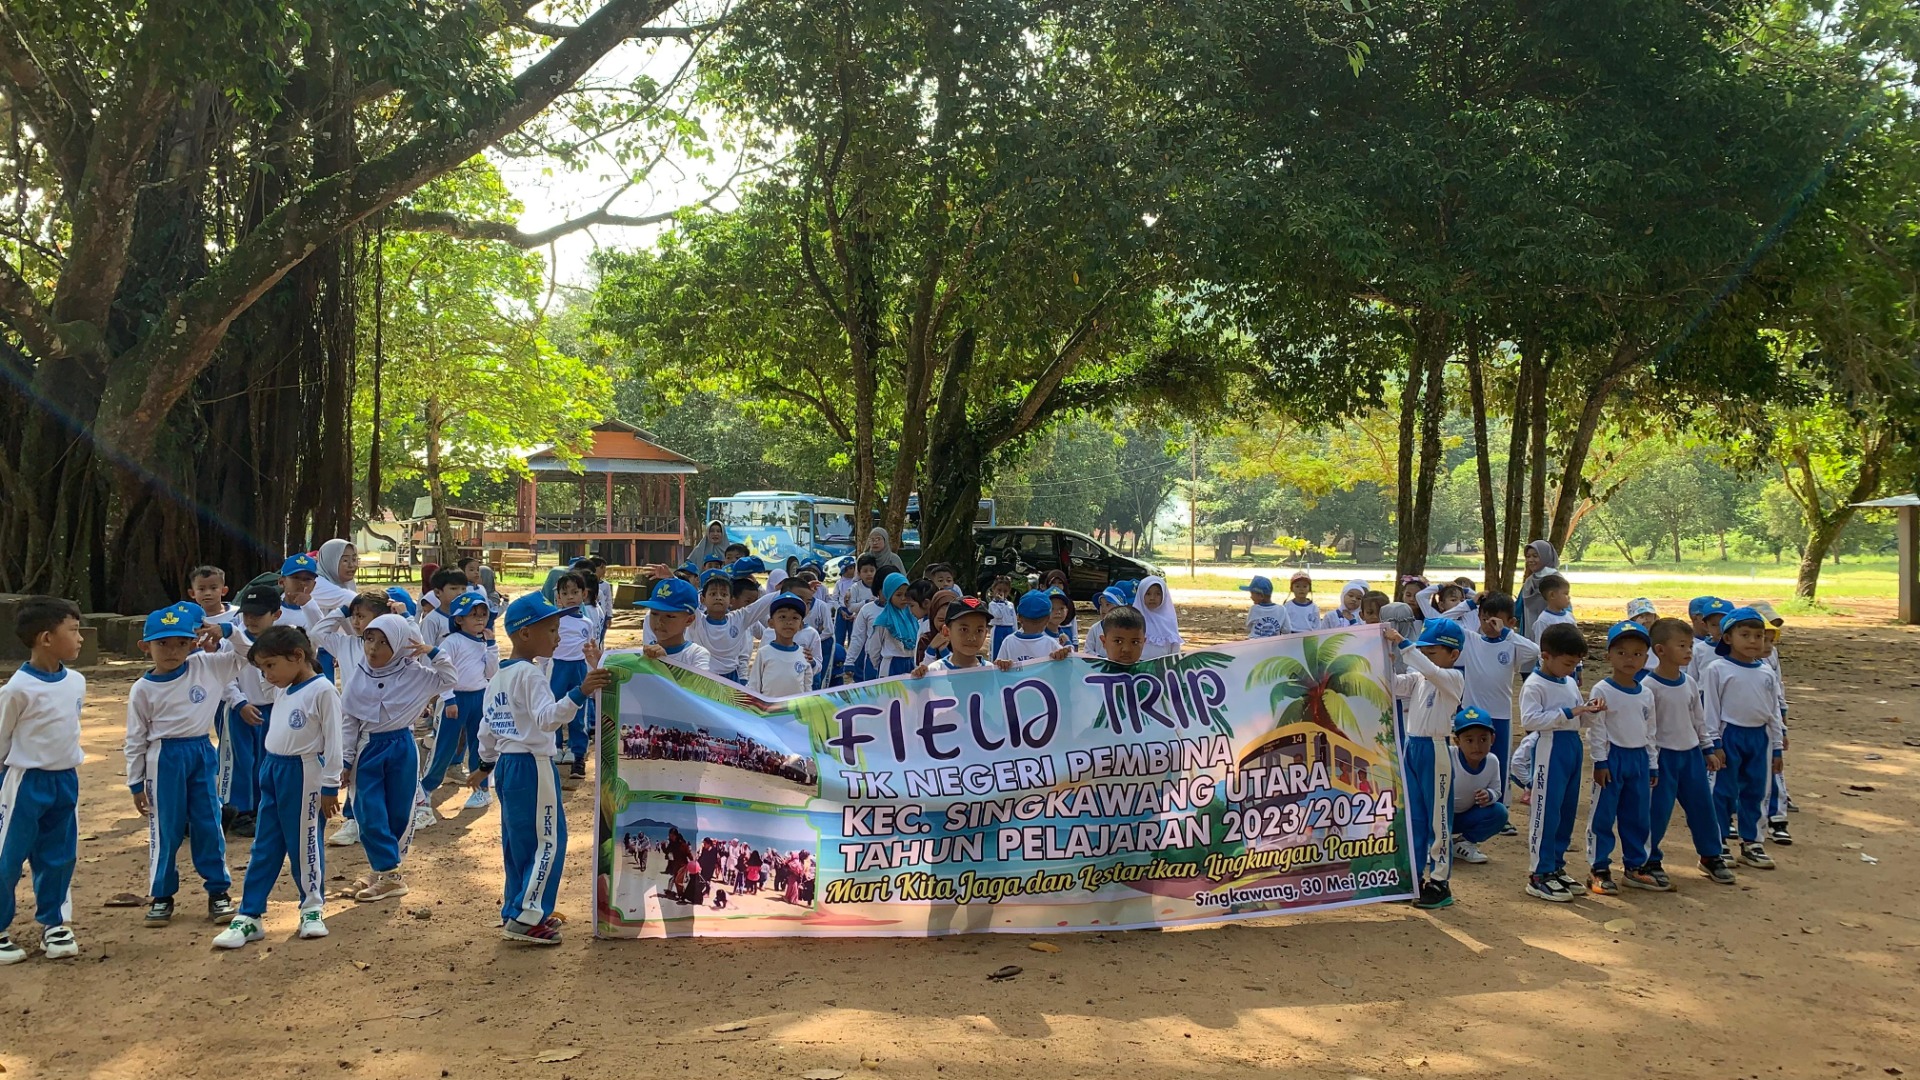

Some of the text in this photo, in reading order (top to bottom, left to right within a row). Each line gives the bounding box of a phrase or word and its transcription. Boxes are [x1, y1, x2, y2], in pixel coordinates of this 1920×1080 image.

[828, 670, 1226, 765] FIELD TRIP
[1291, 734, 1303, 744] 14
[840, 734, 1233, 799] TK NEGERI PEMBINA
[842, 761, 1332, 838] KEC. SINGKAWANG UTARA
[307, 791, 318, 892] TKN PEMBINA
[839, 789, 1396, 873] TAHUN PELAJARAN 2023/2024
[1438, 805, 1448, 864] PEMBINA
[1531, 765, 1545, 854] TKN PEMBINA
[529, 805, 553, 909] TKN PEMBINA
[825, 830, 1398, 905] Mari Kita Jaga dan Lestarikan Lingkungan Pantai
[1194, 869, 1399, 908] Singkawang, 30 Mei 2024
